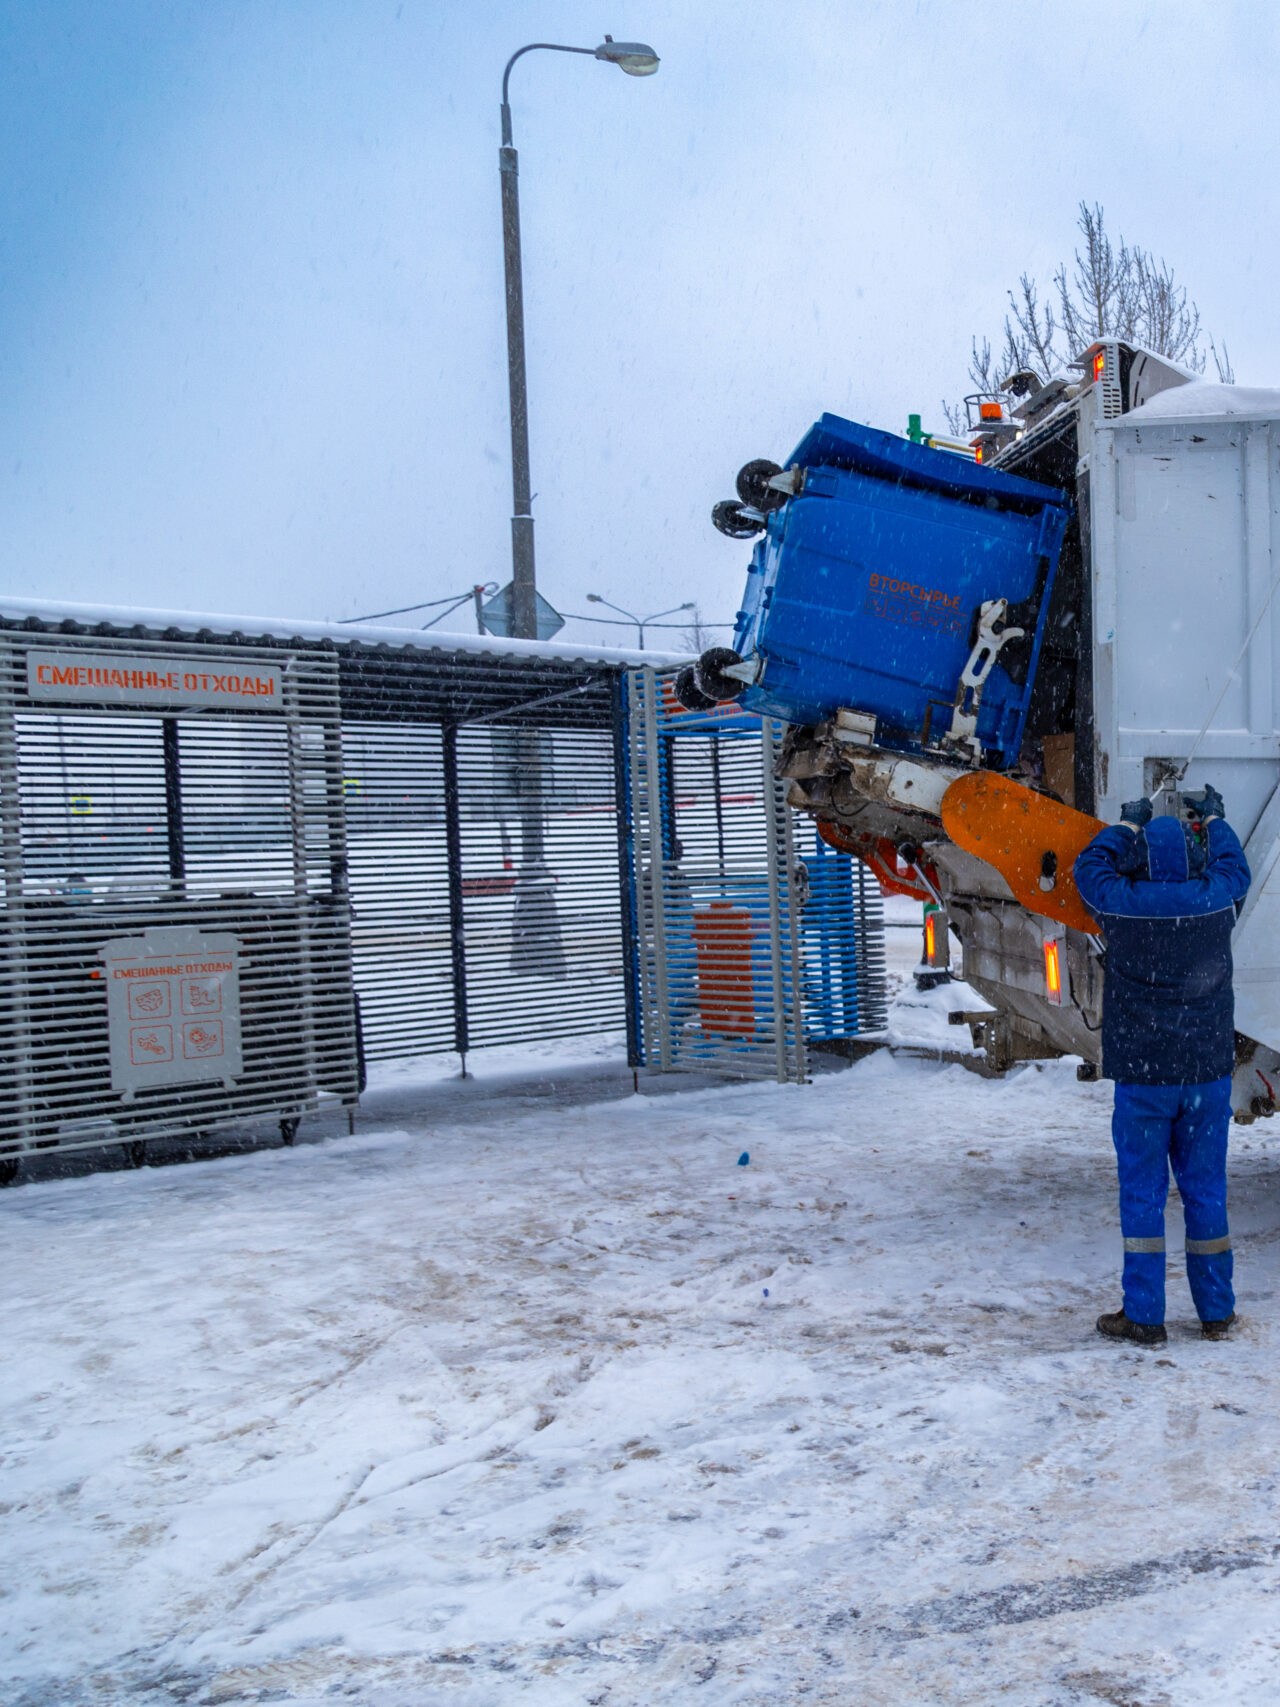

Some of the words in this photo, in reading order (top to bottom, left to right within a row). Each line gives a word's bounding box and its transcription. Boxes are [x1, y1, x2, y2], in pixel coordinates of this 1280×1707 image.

[869, 573, 962, 610] ВТОРСЫРЬЕ
[183, 673, 275, 697] ОТХОДЫ
[185, 961, 233, 974] ОТХОДЫ
